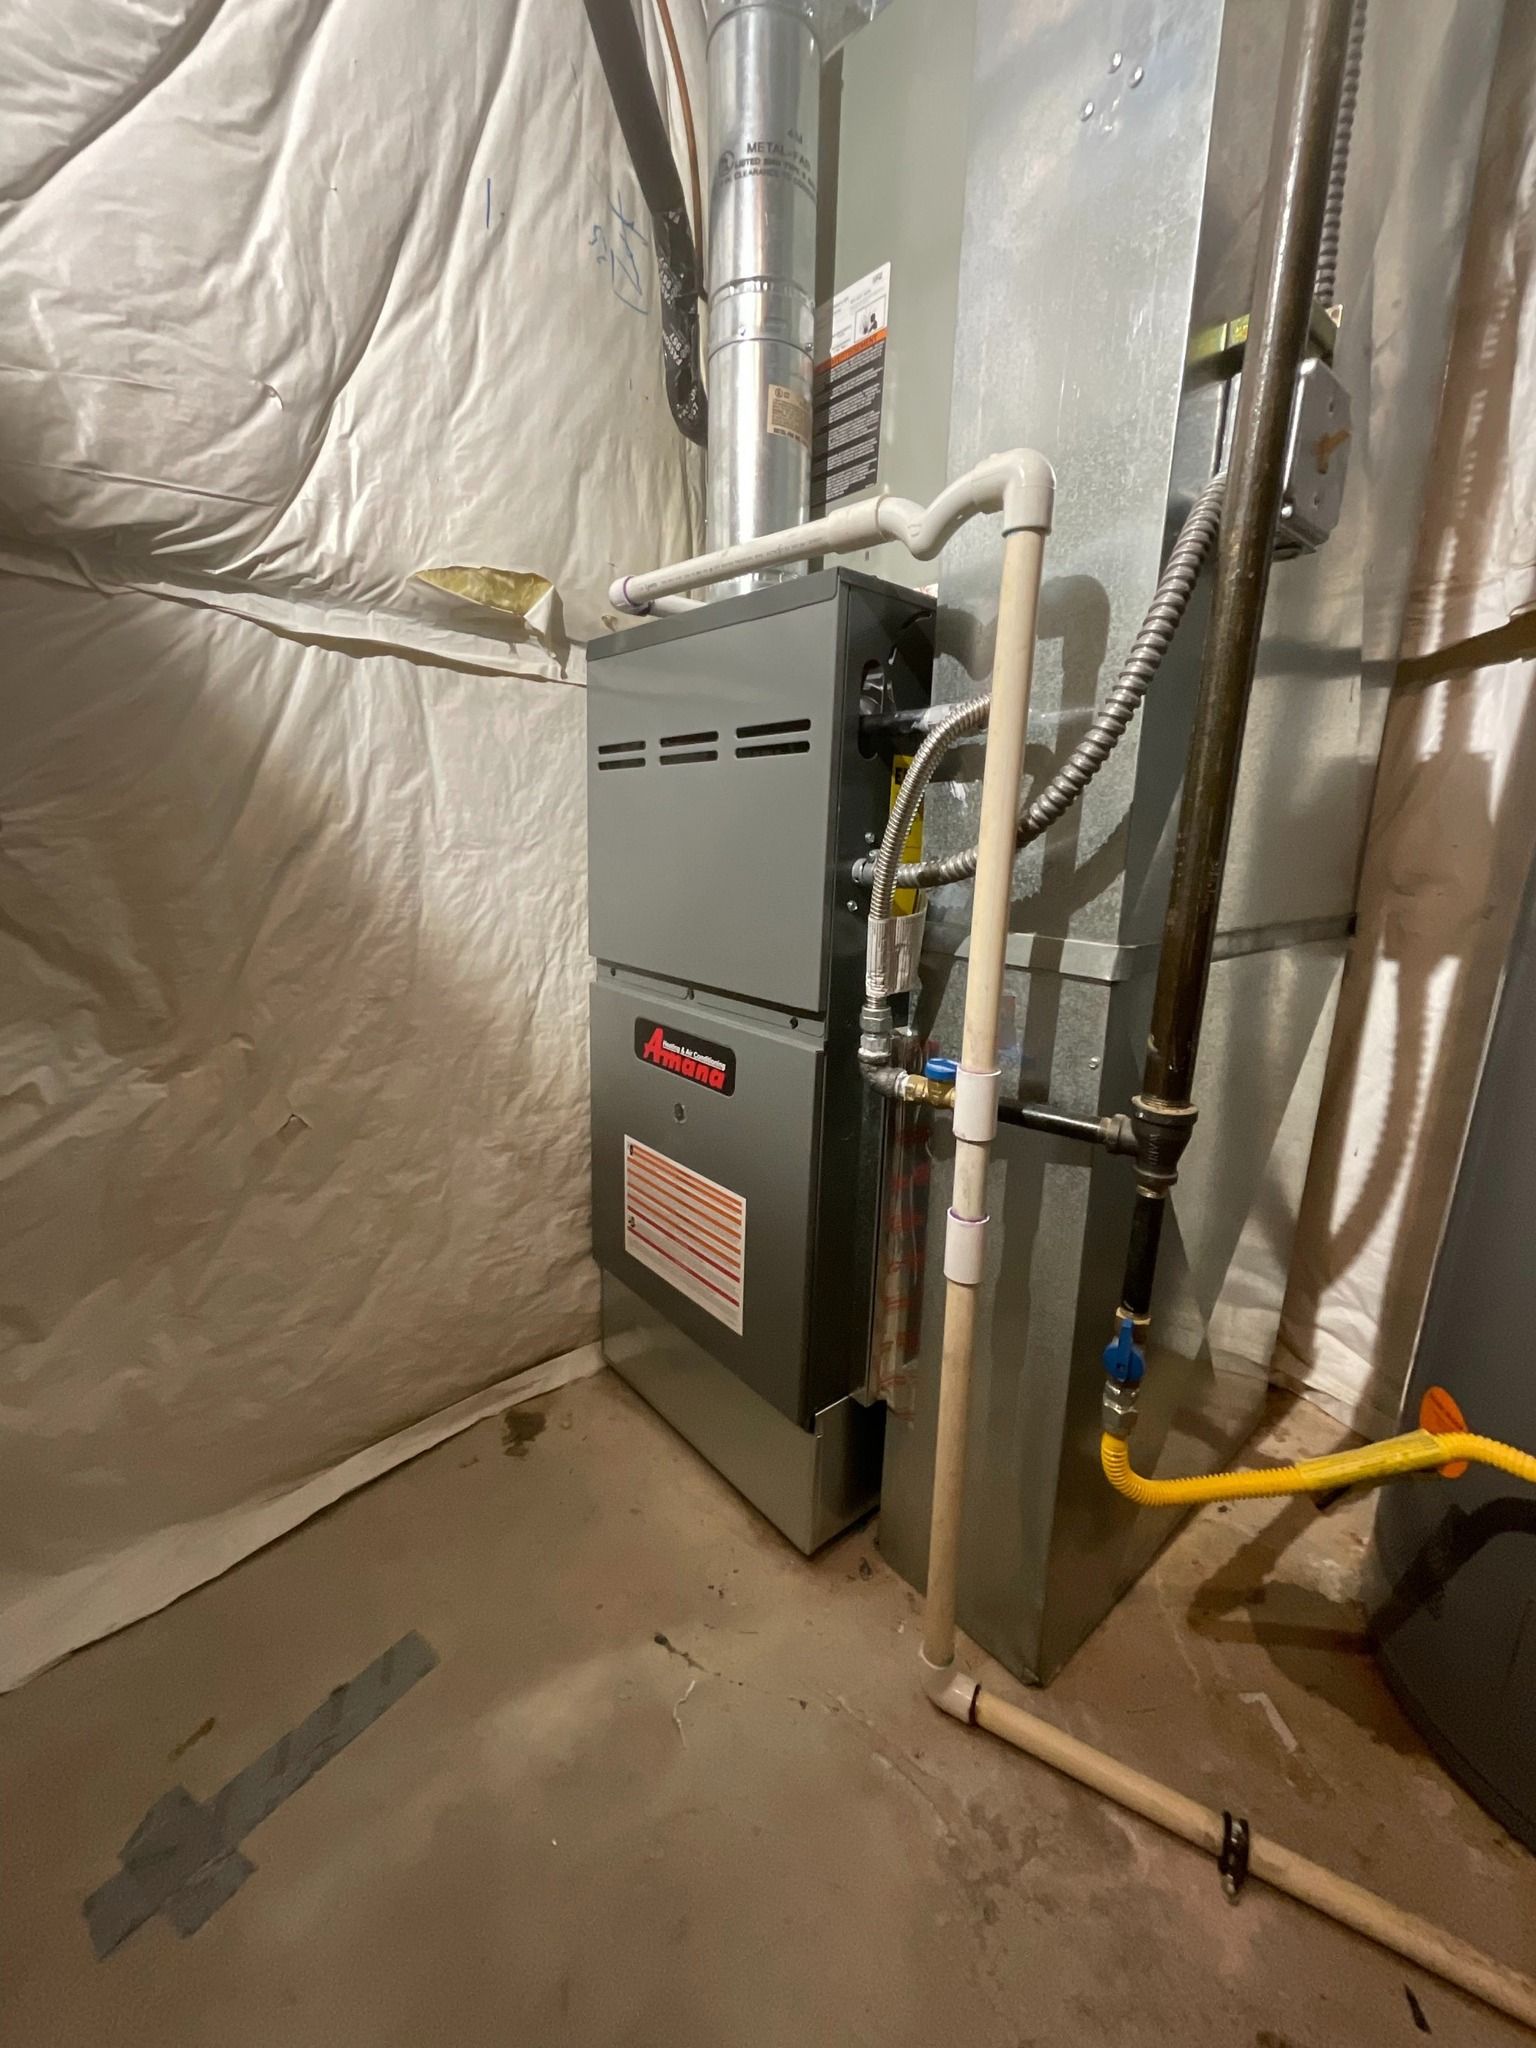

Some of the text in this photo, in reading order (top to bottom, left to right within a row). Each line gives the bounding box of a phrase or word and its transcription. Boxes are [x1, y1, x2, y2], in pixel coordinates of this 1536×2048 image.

[734, 157, 761, 169] LISTED
[643, 1027, 726, 1089] Amana
[685, 1048, 694, 1057] Air
[693, 1051, 726, 1072] Conditioning
